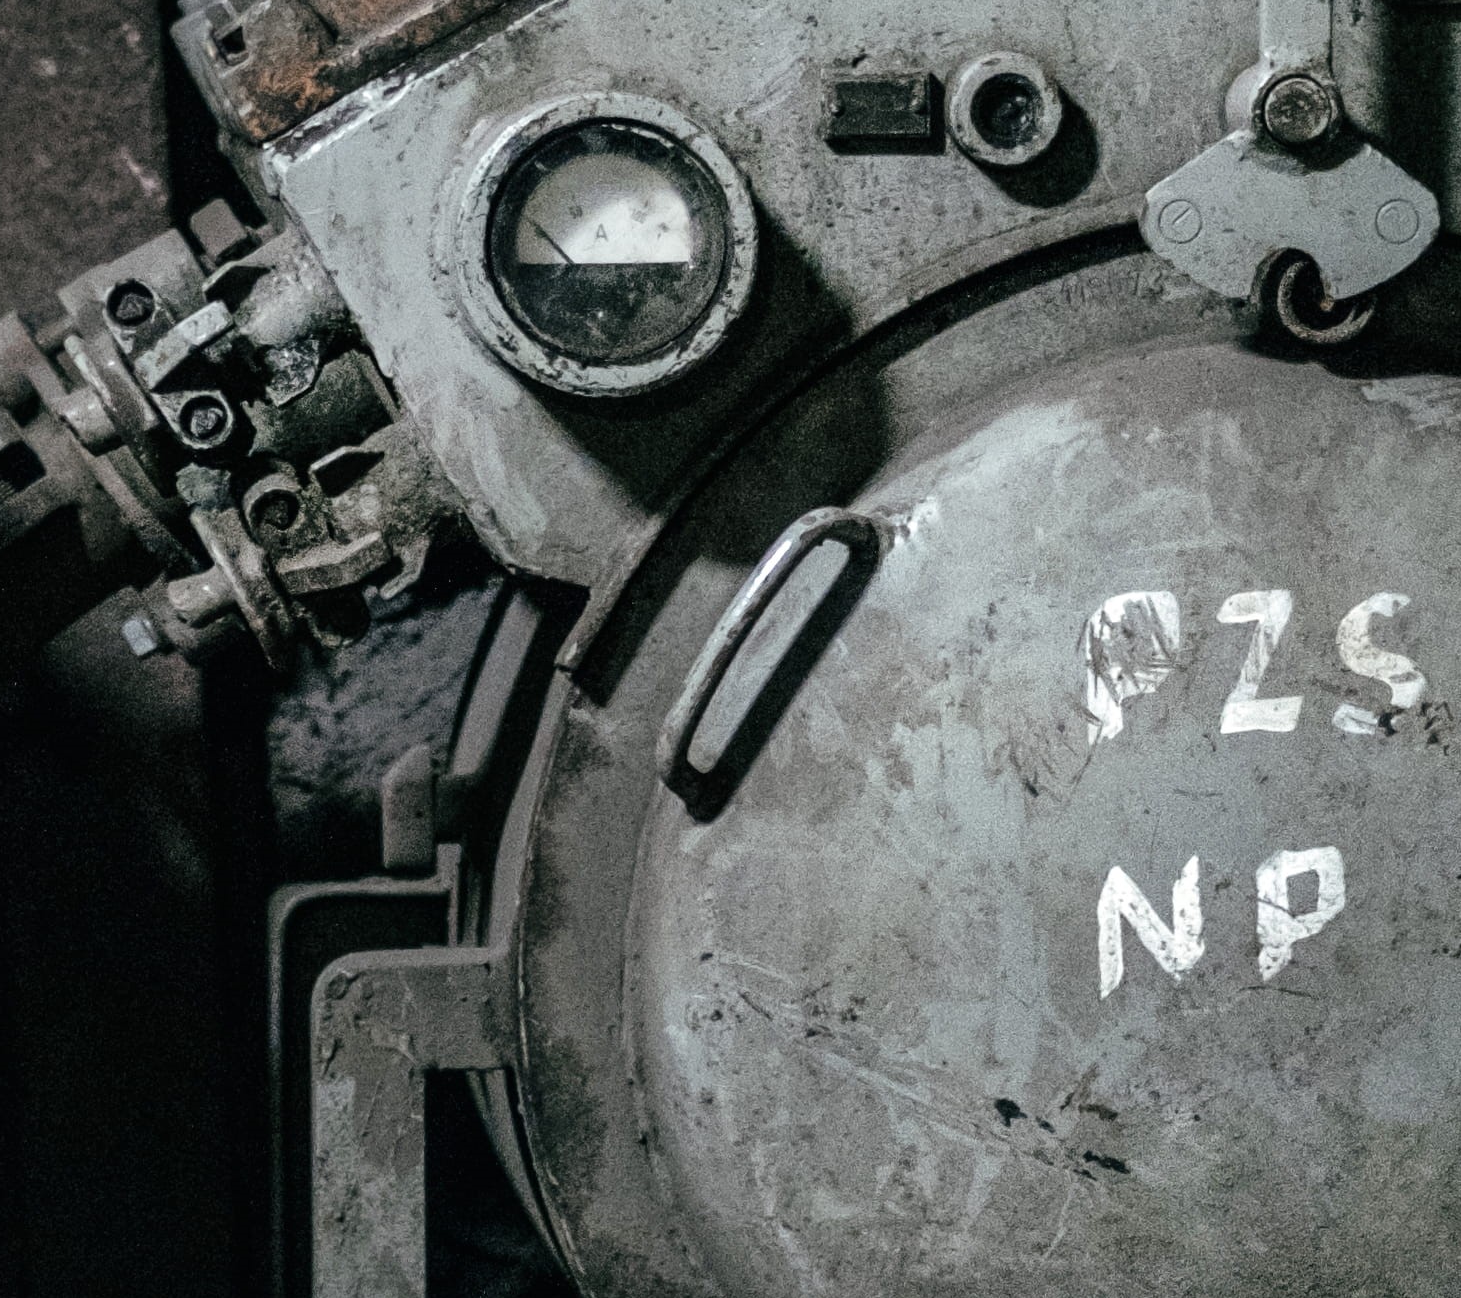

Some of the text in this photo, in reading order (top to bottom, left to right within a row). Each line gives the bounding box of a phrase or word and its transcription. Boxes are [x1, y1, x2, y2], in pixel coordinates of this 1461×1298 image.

[595, 223, 608, 242] A
[1085, 589, 1427, 747] PZS
[1096, 845, 1347, 1001] NP
